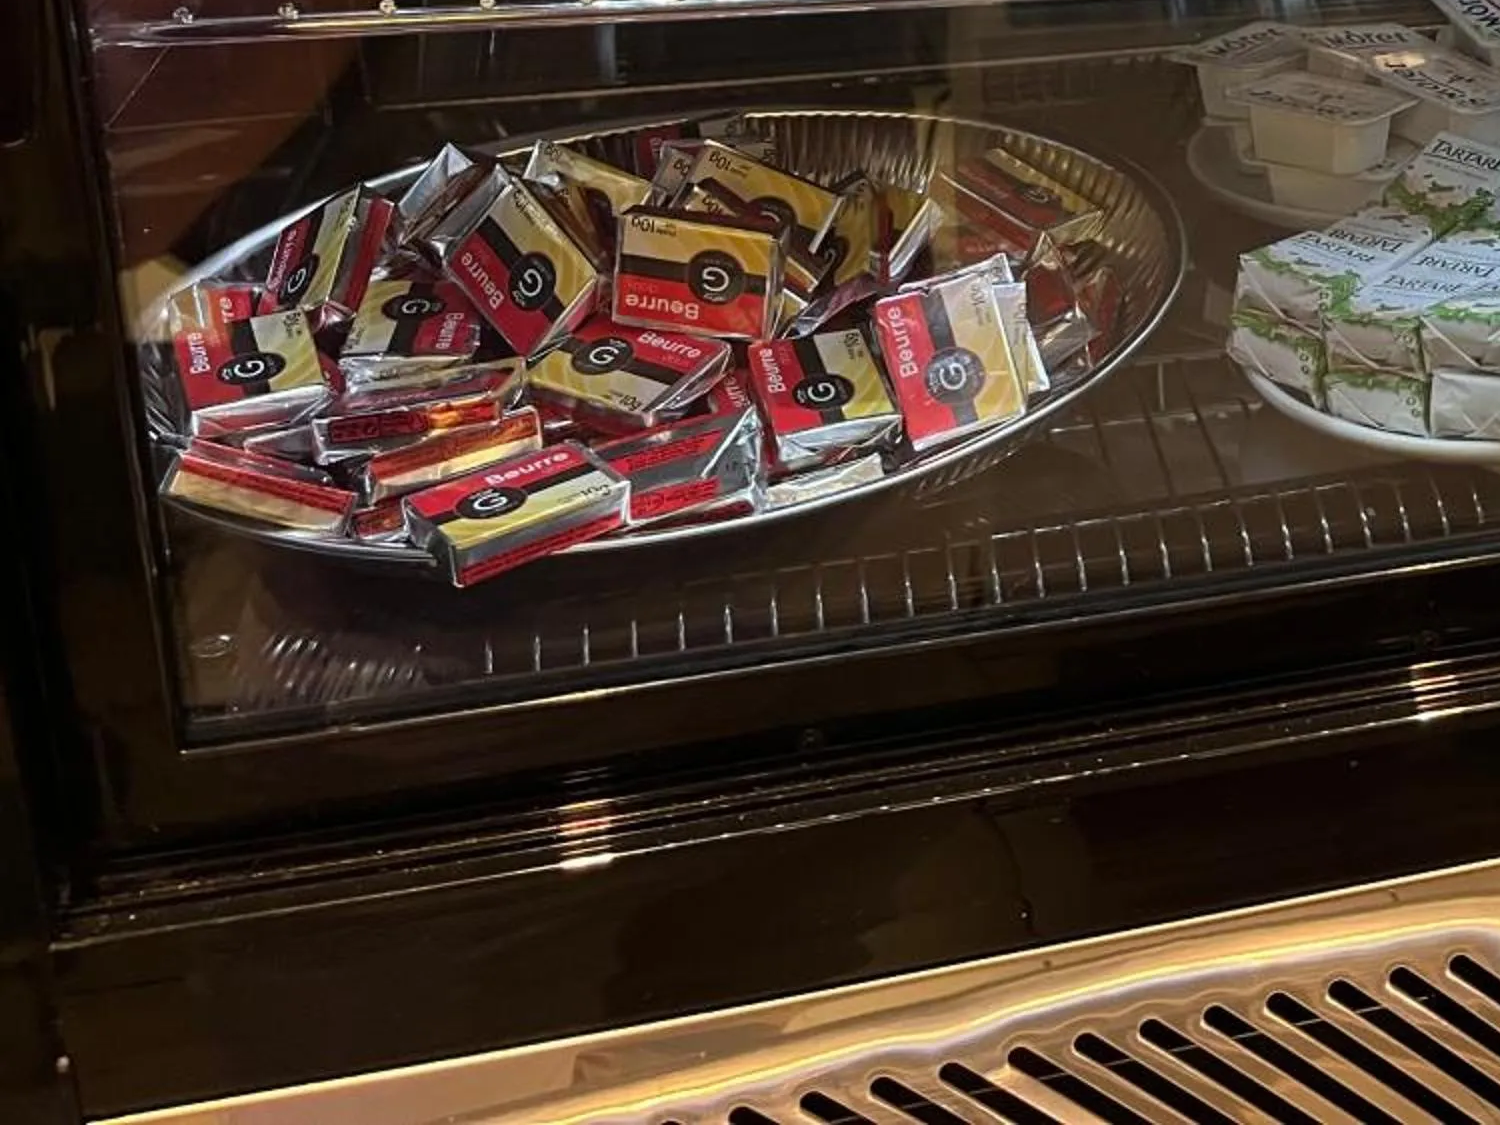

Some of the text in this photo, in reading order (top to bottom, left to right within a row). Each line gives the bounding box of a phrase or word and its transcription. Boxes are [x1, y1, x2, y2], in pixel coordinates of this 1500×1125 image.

[461, 251, 505, 310] Beurre
[625, 294, 700, 320] Beurre
[186, 331, 212, 374] Beurre
[637, 332, 702, 358] Beurre
[886, 306, 919, 378] Beurre
[759, 348, 787, 394] Beurre
[482, 452, 570, 486] Beurre
